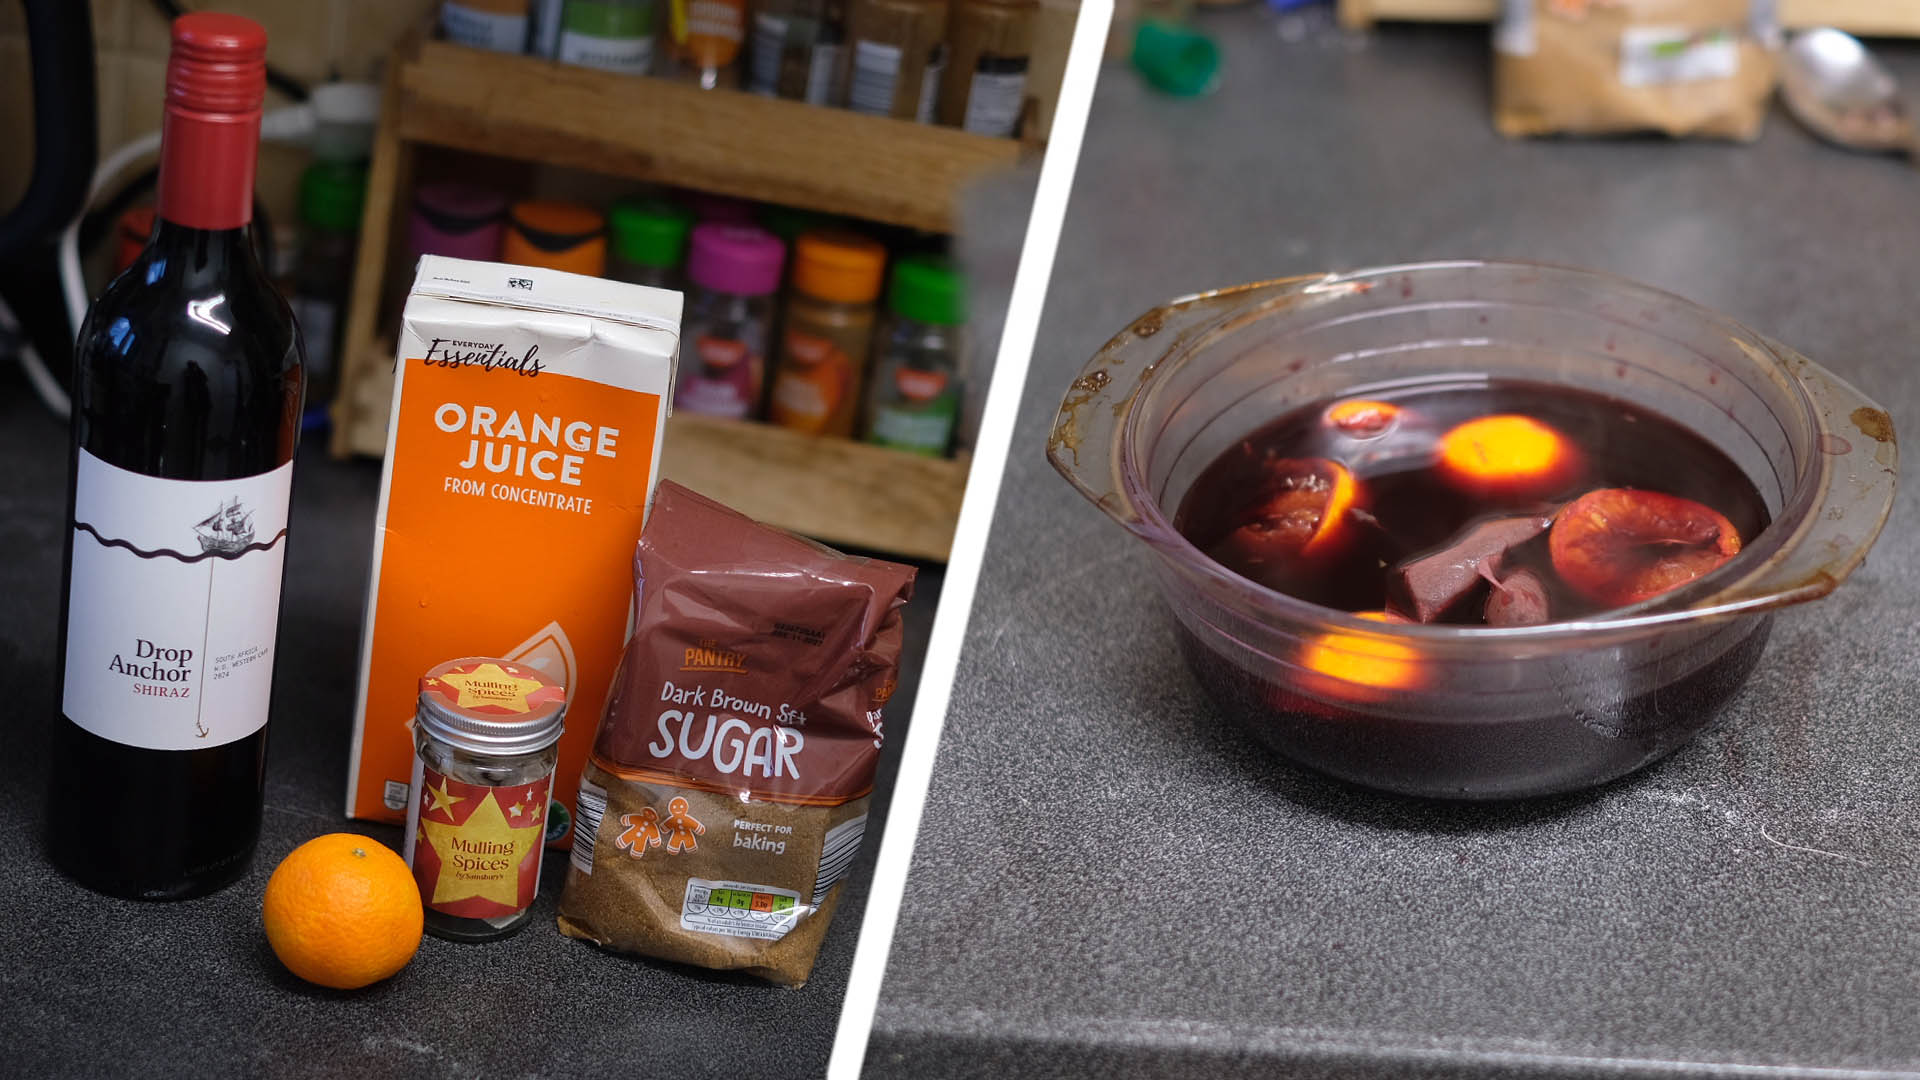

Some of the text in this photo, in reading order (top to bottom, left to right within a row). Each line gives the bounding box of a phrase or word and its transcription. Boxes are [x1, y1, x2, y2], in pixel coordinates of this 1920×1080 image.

[452, 340, 495, 350] EVERYDAY
[424, 338, 546, 378] Essentials
[434, 402, 620, 459] ORANGE
[459, 439, 585, 487] JUICE
[443, 476, 593, 515] FROM CONCENTRATE
[136, 638, 193, 668] Drop
[684, 647, 746, 668] PANTRY
[109, 654, 192, 682] Anchor
[133, 683, 190, 698] SHIRAZ
[464, 680, 519, 691] Mulling
[467, 688, 516, 697] Spices
[661, 680, 706, 706] Dark
[710, 688, 771, 720] Brown
[649, 709, 804, 780] SUGAR
[733, 819, 792, 835] PERFECT FOR
[451, 837, 515, 856] Mulling
[733, 831, 786, 855] baking
[453, 854, 509, 871] Spices
